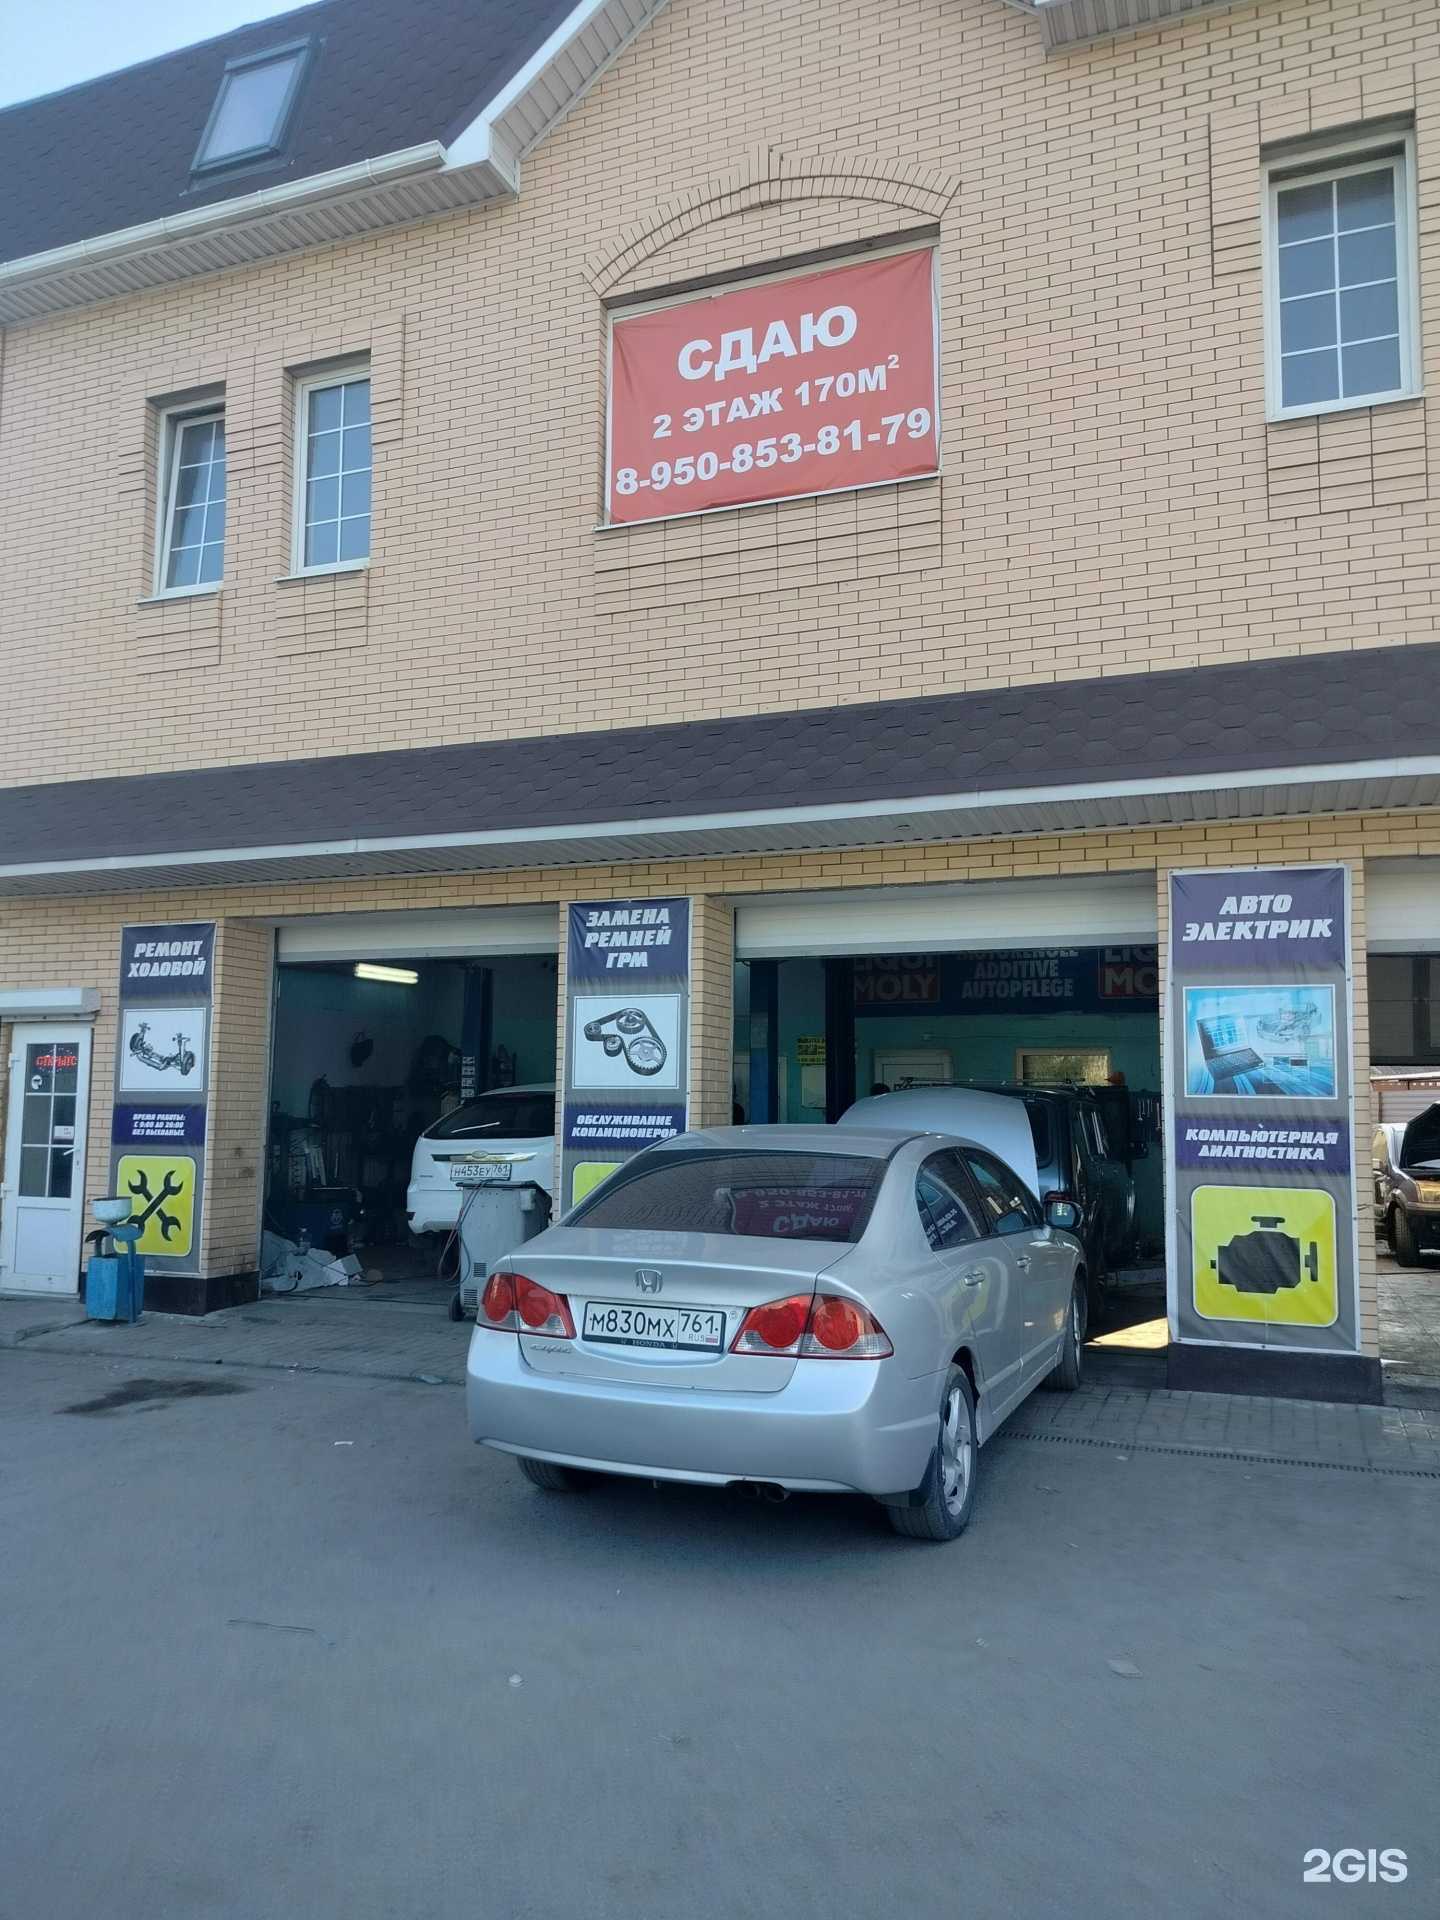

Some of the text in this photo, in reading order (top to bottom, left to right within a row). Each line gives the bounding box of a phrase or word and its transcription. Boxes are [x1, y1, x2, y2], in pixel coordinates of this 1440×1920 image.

[678, 305, 858, 381] СДАЮ
[653, 414, 672, 439] 2
[683, 387, 784, 432] ЭТАЖ
[616, 407, 931, 496] 8-950-853-81-79
[1219, 893, 1293, 916] АВТО
[586, 907, 670, 928] ЗАМЕНА
[584, 926, 672, 948] РЕМНЕЙ
[1182, 918, 1334, 943] ЭЛЕКТРИК
[134, 940, 203, 958] РЕМОНТ
[128, 957, 207, 978] ХОДОВОЙ
[606, 952, 649, 969] ГРМ
[975, 960, 1058, 978] ADDITIVE
[961, 978, 1074, 999] AUTOPFLEGE
[576, 1114, 673, 1126] ОБСЛУЖИВАНИЕ
[571, 1127, 678, 1139] КОНДИЦИОНЕРОВ
[1185, 1128, 1339, 1145] КОМПЬЮТЕРНАЯ
[1198, 1144, 1325, 1161] ДИАГНОСТИКА
[681, 1313, 715, 1334] 761
